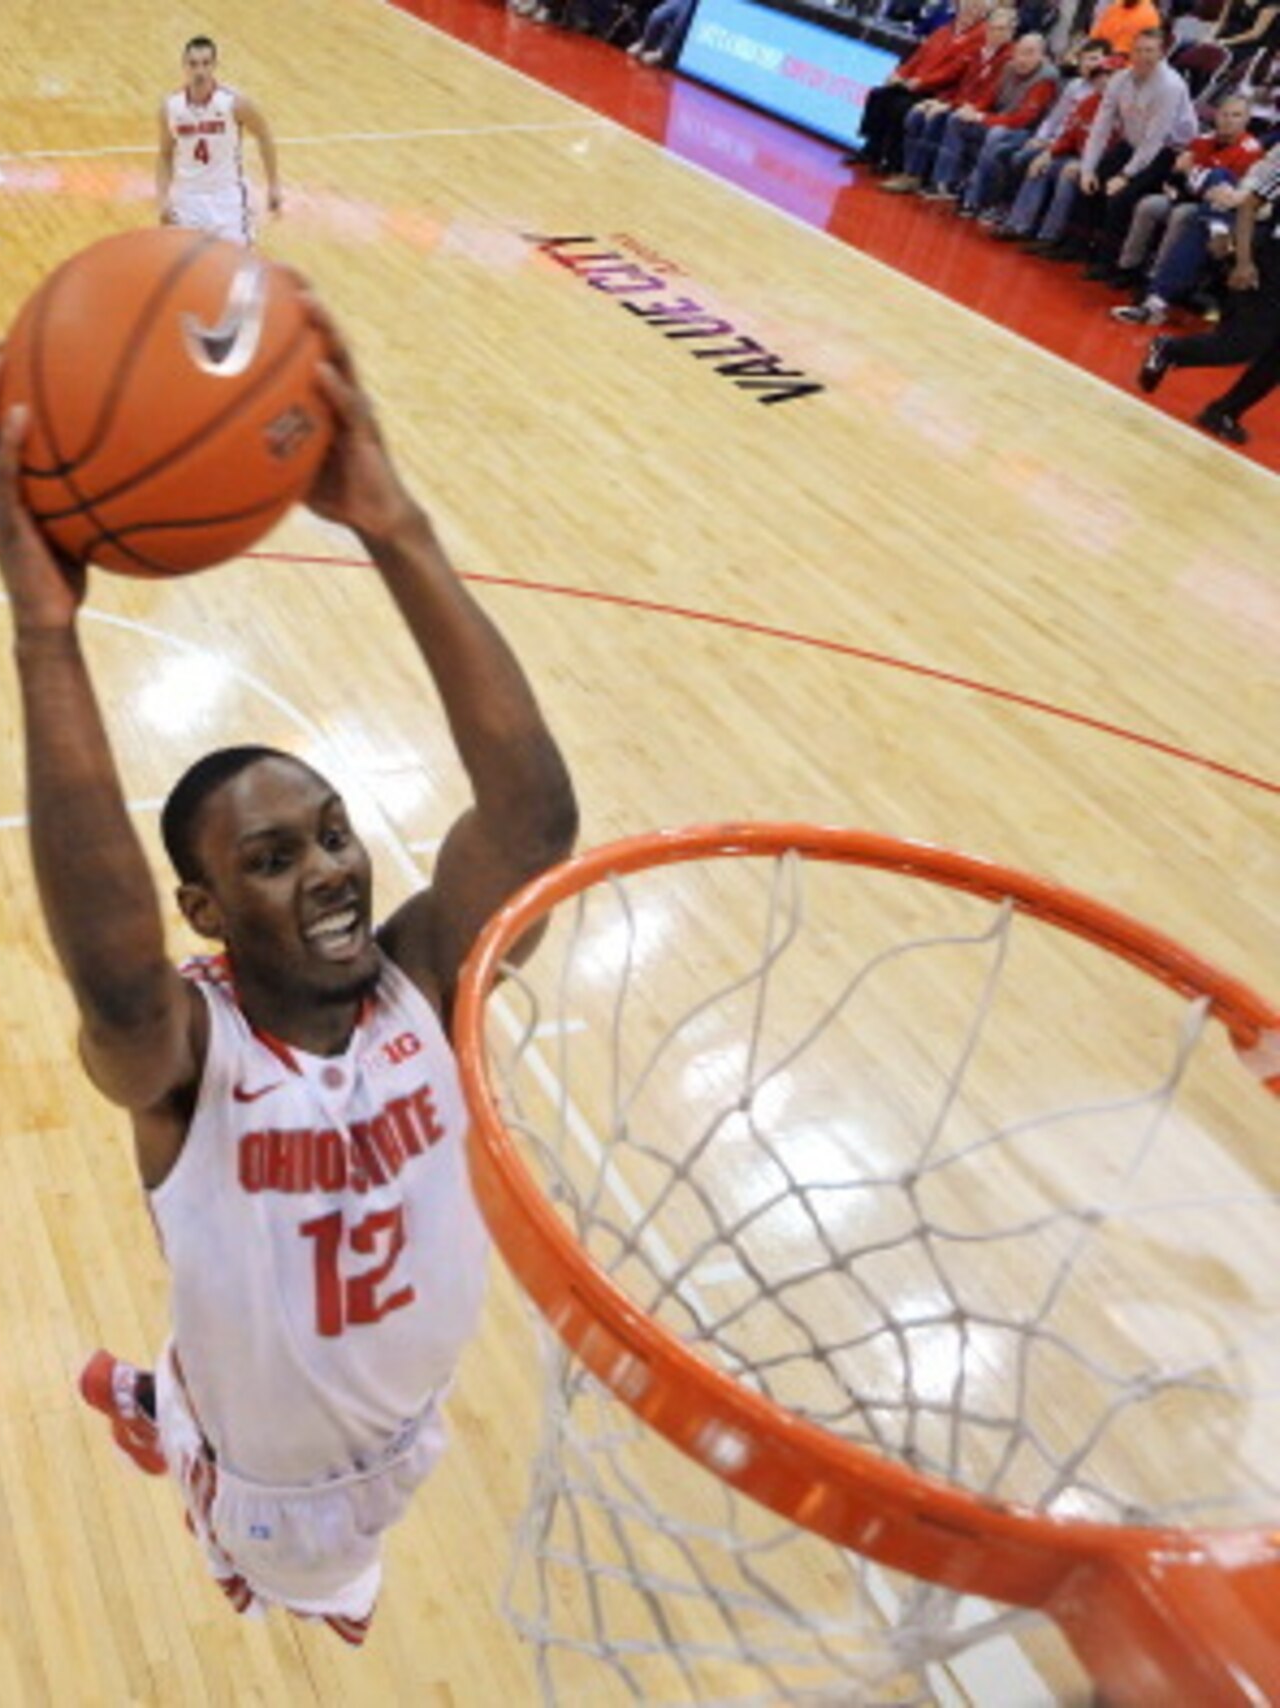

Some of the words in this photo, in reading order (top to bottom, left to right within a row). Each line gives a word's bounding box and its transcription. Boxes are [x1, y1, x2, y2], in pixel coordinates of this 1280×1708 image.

[194, 138, 209, 165] 4
[521, 233, 666, 295] CITY
[620, 299, 824, 406] VALUE
[238, 1128, 347, 1194] OHIO
[299, 1203, 416, 1338] 12
